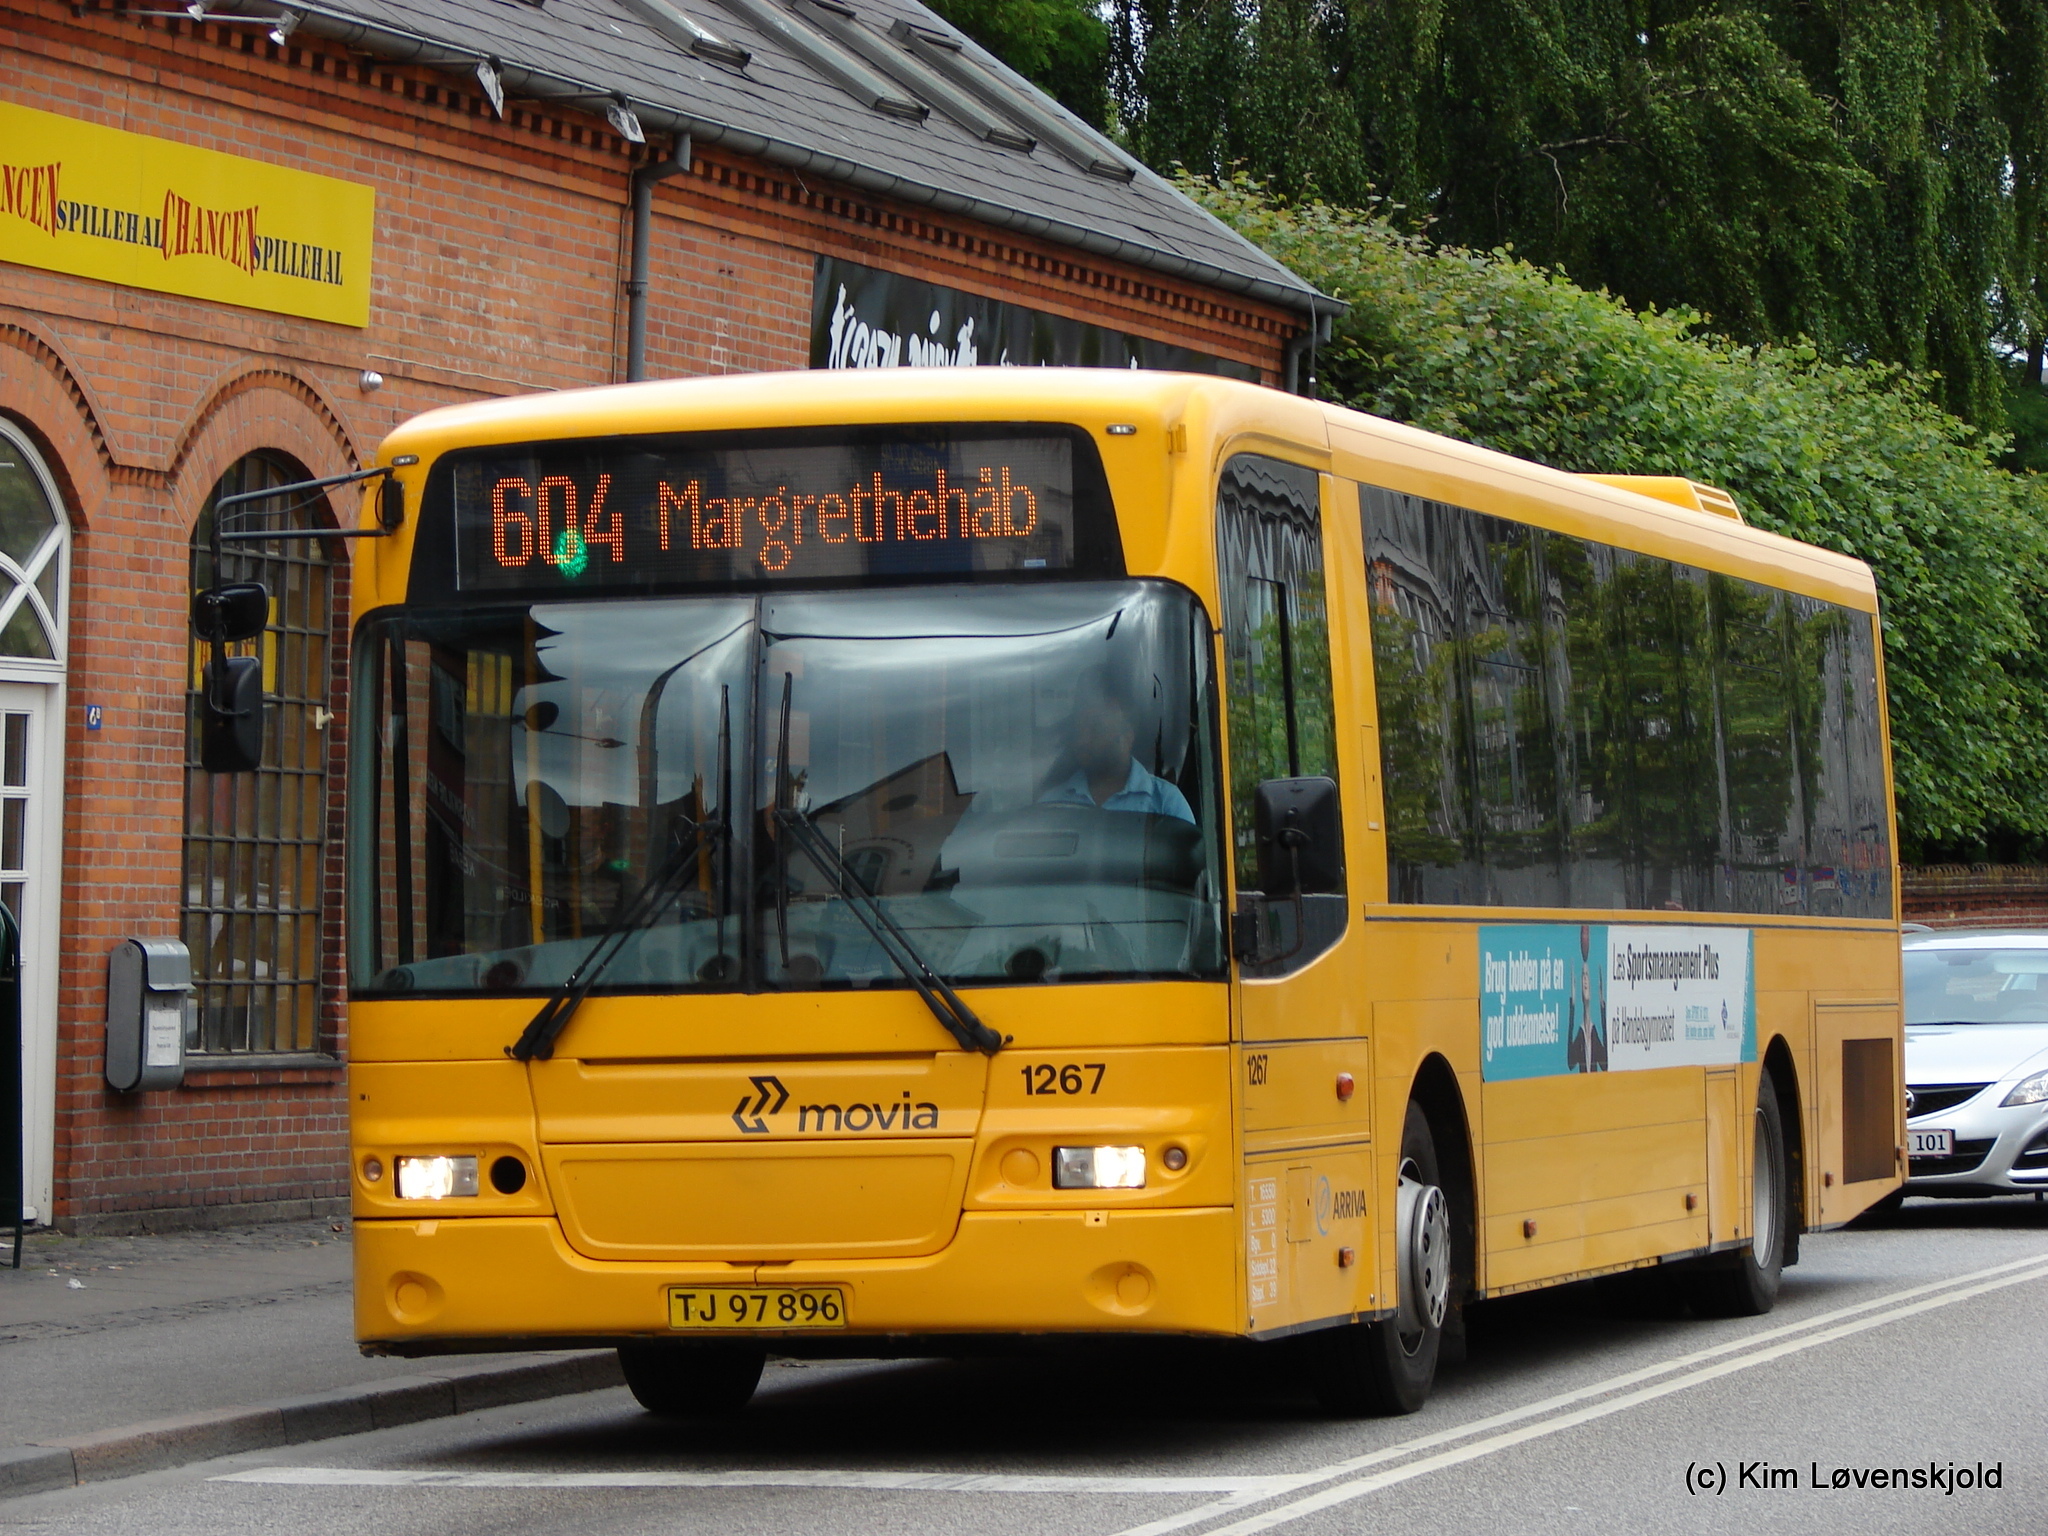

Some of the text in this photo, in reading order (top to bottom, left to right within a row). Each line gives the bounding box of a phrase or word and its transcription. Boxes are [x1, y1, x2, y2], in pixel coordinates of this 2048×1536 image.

[56, 199, 163, 249] SPILLEHAL
[160, 188, 260, 278] CHANCEN
[251, 234, 344, 287] SPILLEHAL
[493, 466, 1037, 572] 604 Margrethehåb
[1485, 946, 1564, 1006] Brug bolden på en
[1626, 942, 1702, 992] Sportsmanagement
[1703, 943, 1720, 981] Plus
[1486, 1002, 1559, 1062] god uddannelse!
[1611, 1005, 1620, 1054] på
[1020, 1063, 1107, 1096] 1267
[1246, 1054, 1269, 1086] 1267
[798, 1091, 939, 1133] movia
[1916, 1134, 1946, 1151] 101
[1332, 1189, 1368, 1221] ARRIVA
[675, 1293, 839, 1322] TJ 97 896
